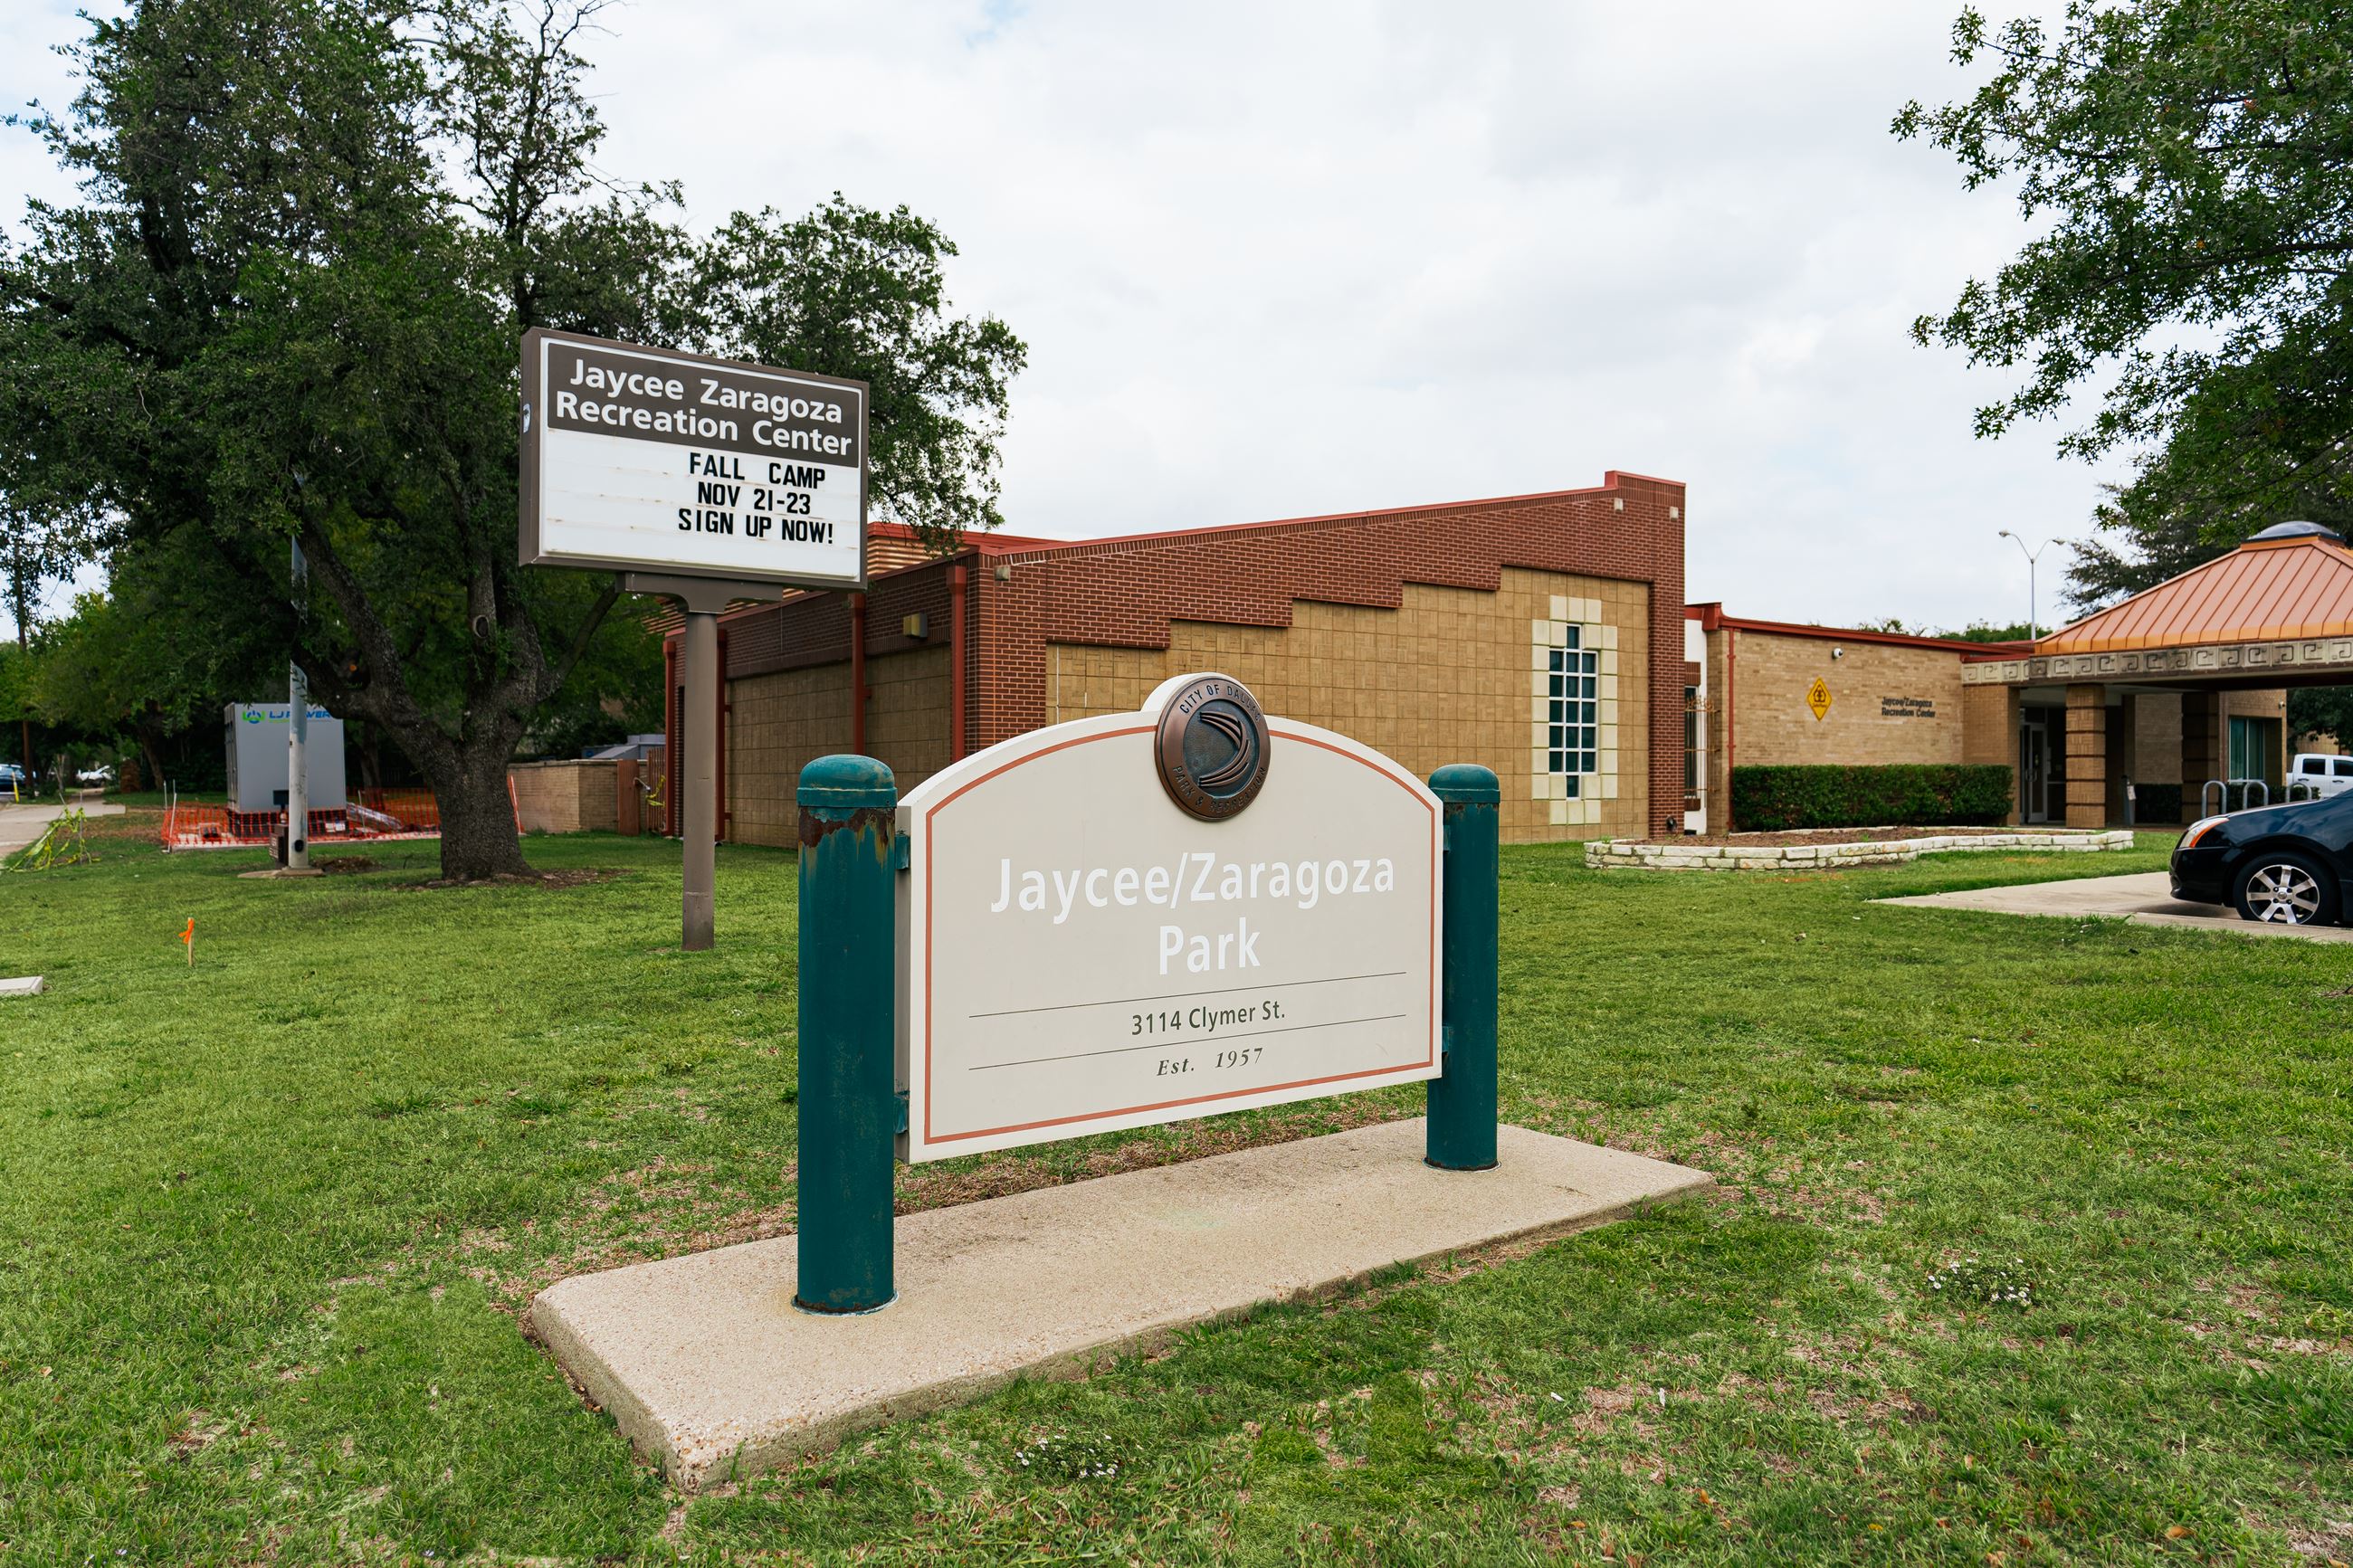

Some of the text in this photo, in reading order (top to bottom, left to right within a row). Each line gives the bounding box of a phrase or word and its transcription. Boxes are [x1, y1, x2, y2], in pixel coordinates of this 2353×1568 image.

[570, 358, 843, 423] Jaycee Zaragoza
[557, 390, 852, 456] Recreation Center
[689, 452, 825, 489] FALL CAMP
[697, 481, 812, 515] NOV 21-23
[678, 508, 834, 545] SIGN UP NOW!
[1179, 684, 1261, 721] CITY OF DALLAS
[1173, 765, 1266, 813] PARK & RECREATION
[991, 851, 1395, 924] Jaycee/Zaragoza
[1158, 917, 1261, 975] Park
[1131, 1000, 1286, 1036] 3114 Clymer St.
[1156, 1047, 1264, 1076] Est. 1957
